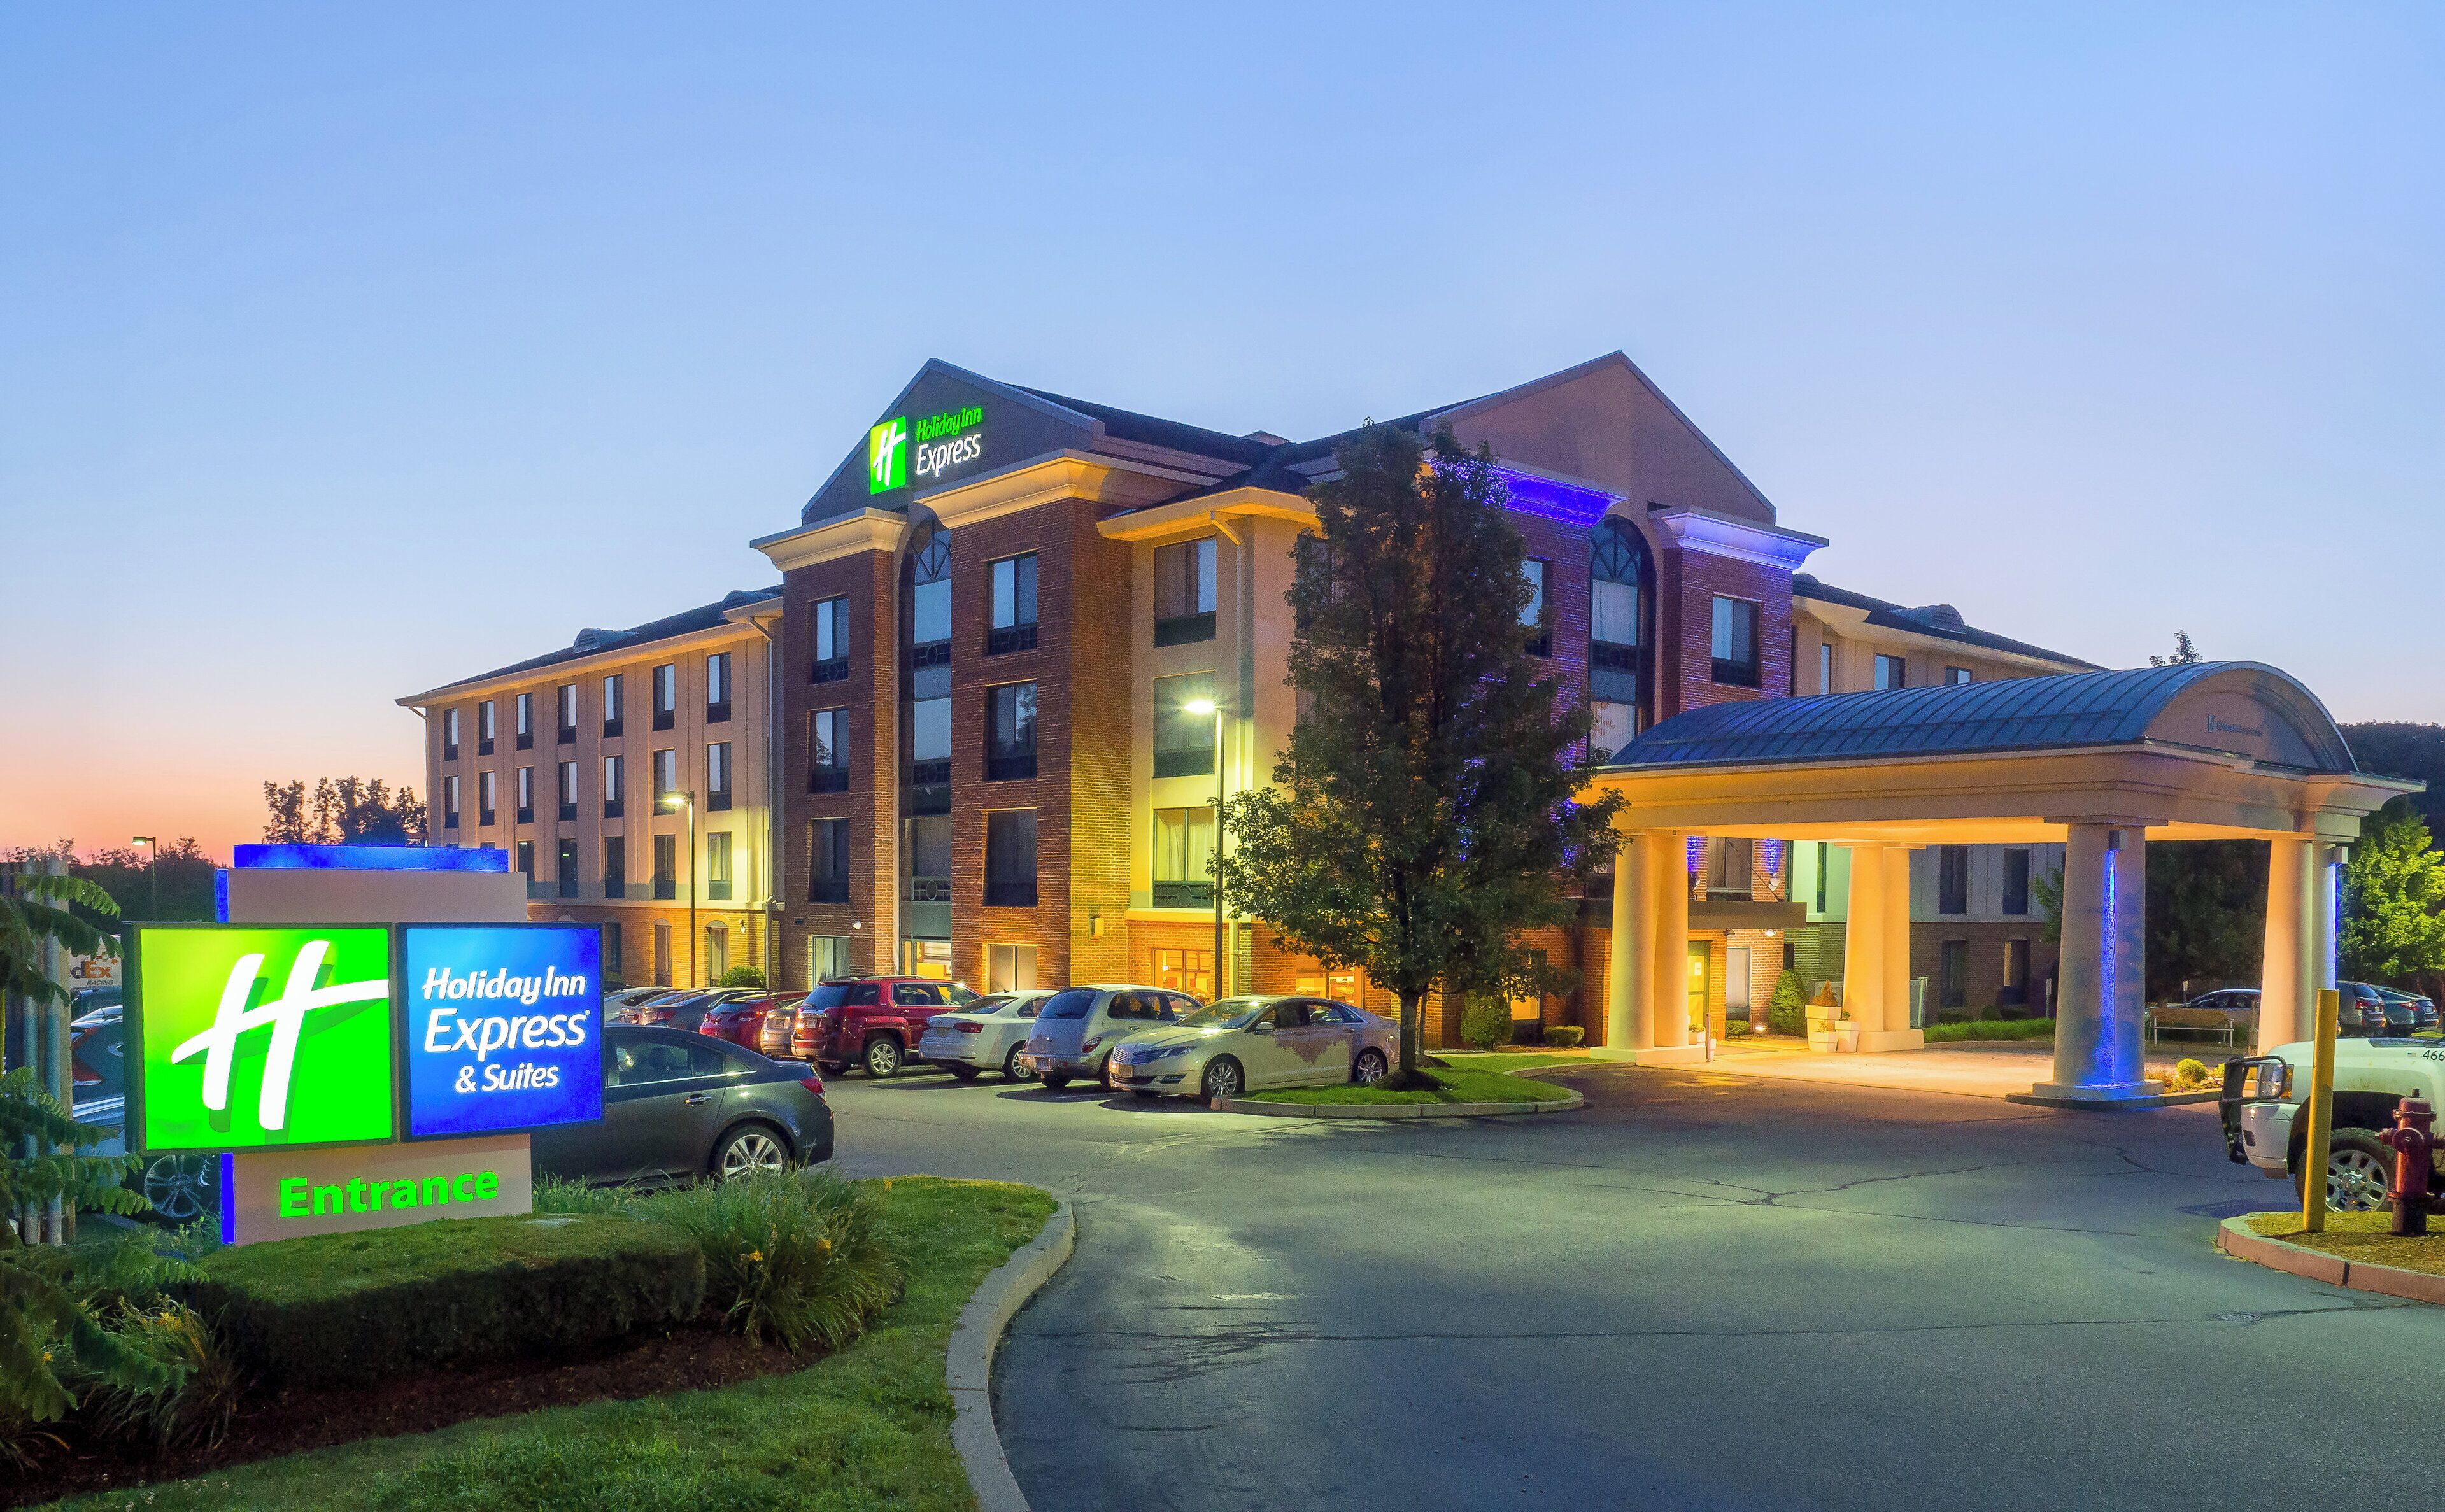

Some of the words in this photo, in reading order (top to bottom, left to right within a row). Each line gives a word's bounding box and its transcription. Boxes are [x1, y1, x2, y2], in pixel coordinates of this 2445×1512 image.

[916, 413, 960, 442] Holiday
[961, 407, 982, 428] Inn
[916, 433, 981, 478] Express
[70, 961, 113, 979] dEx
[422, 967, 542, 1005] Holiday
[544, 966, 586, 997] Inn
[424, 1008, 588, 1062] Express
[2421, 1050, 2445, 1061] 466
[455, 1065, 477, 1093] &
[481, 1063, 560, 1092] Suites
[279, 1171, 499, 1217] Entrance
